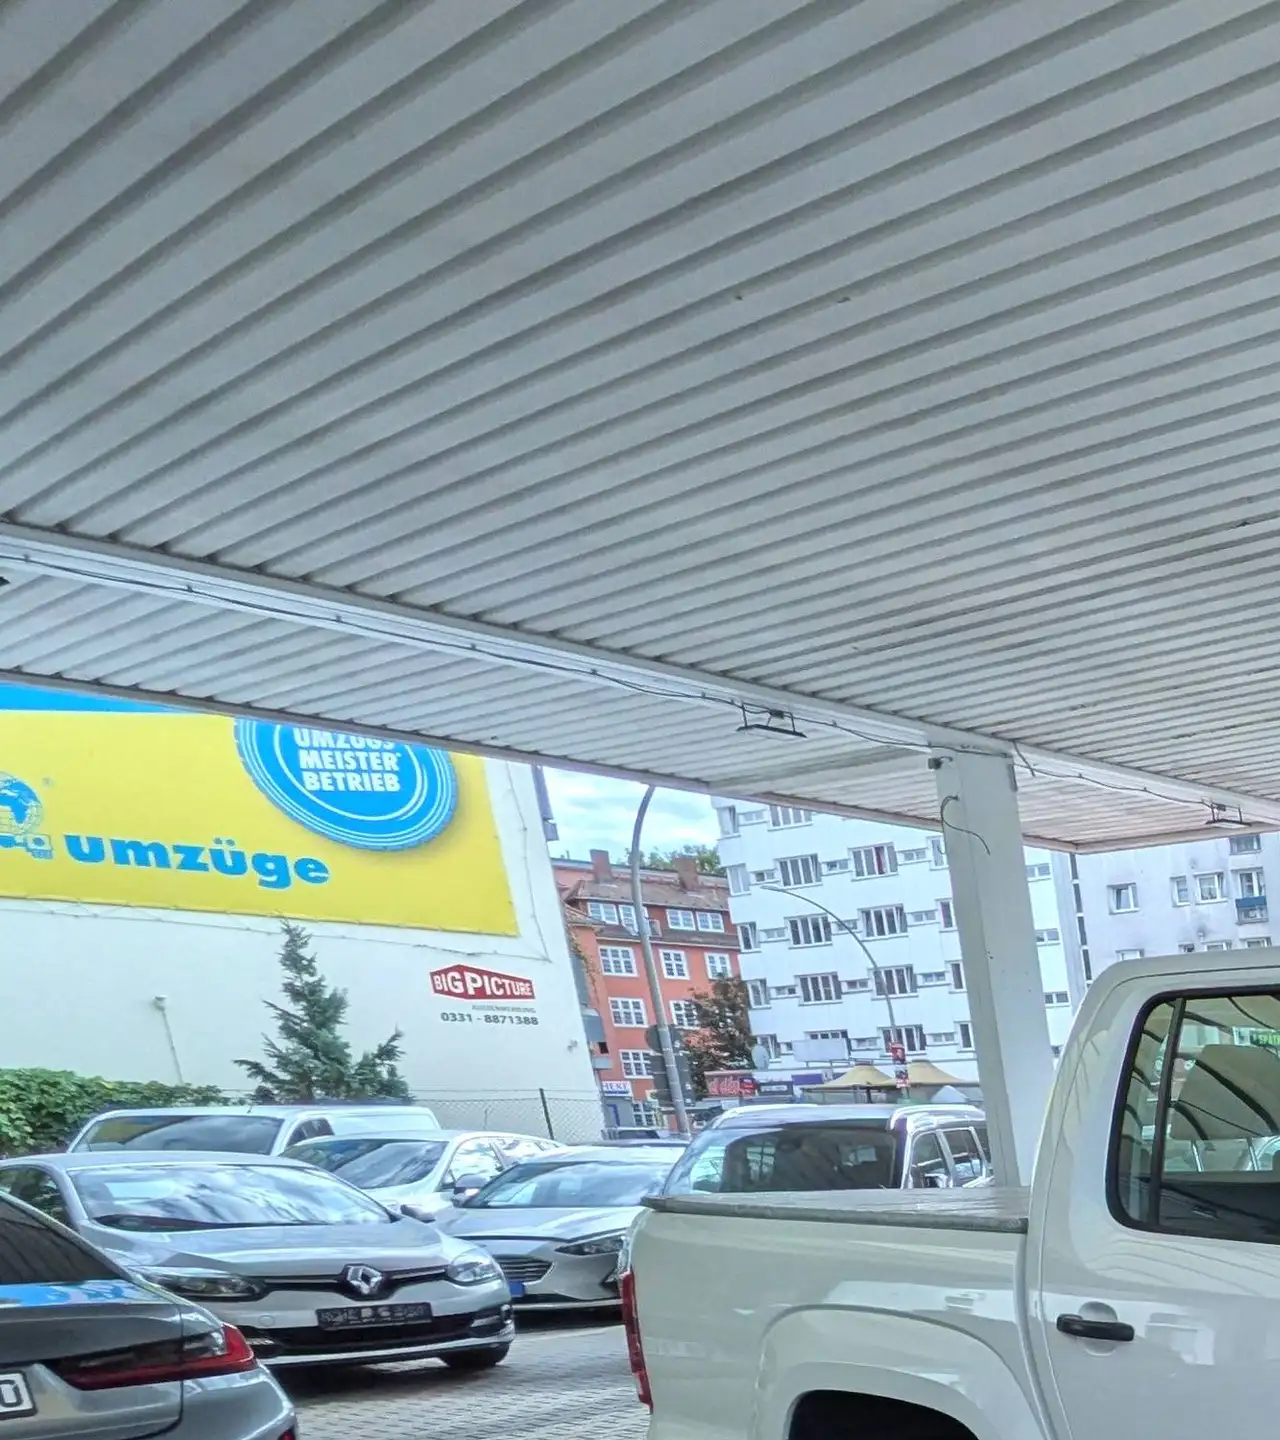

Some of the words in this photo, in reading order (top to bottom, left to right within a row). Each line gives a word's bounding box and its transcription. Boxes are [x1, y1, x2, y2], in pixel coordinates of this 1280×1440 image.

[300, 751, 399, 772] MEISTER
[303, 770, 401, 792] BETRIEB
[63, 833, 330, 890] umzüge
[440, 1011, 473, 1023] 0331
[483, 1014, 540, 1026] 8871388
